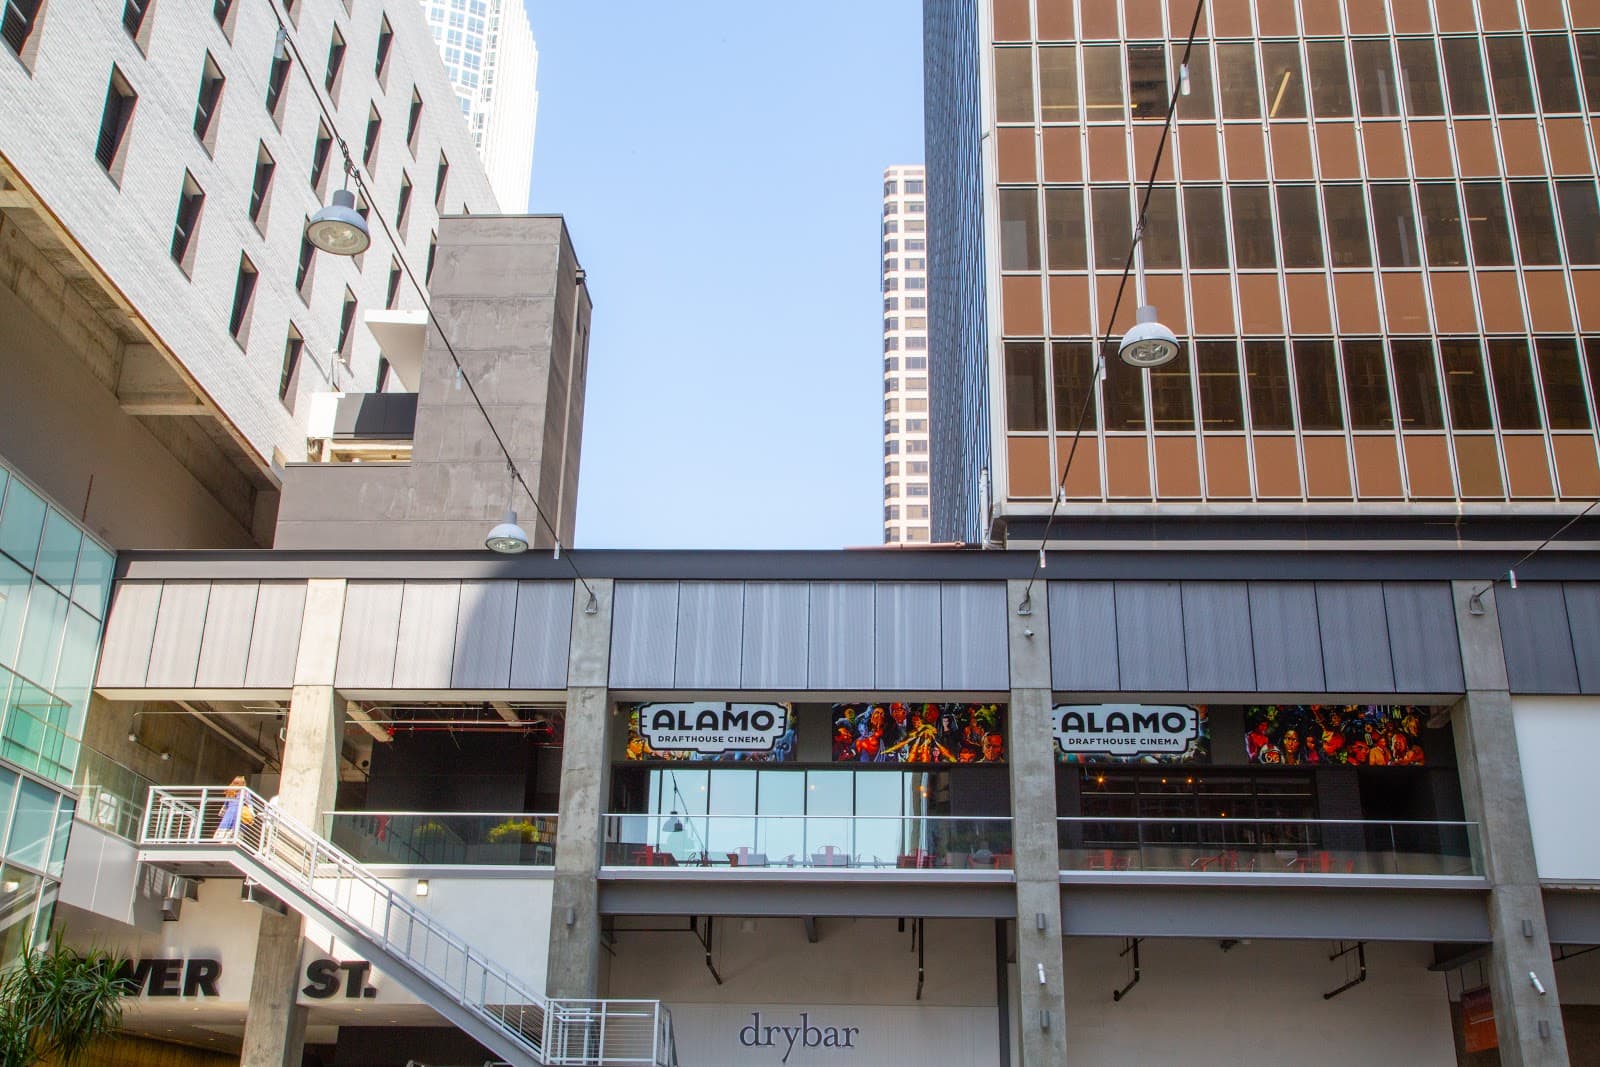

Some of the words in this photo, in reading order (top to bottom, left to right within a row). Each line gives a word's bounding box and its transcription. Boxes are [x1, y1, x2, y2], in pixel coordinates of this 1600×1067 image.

[652, 709, 775, 731] ALAMO
[1061, 711, 1186, 733] ALAMO
[658, 735, 724, 743] DRAFTHOUSE
[302, 958, 377, 998] ST.
[740, 1012, 859, 1063] drybar
